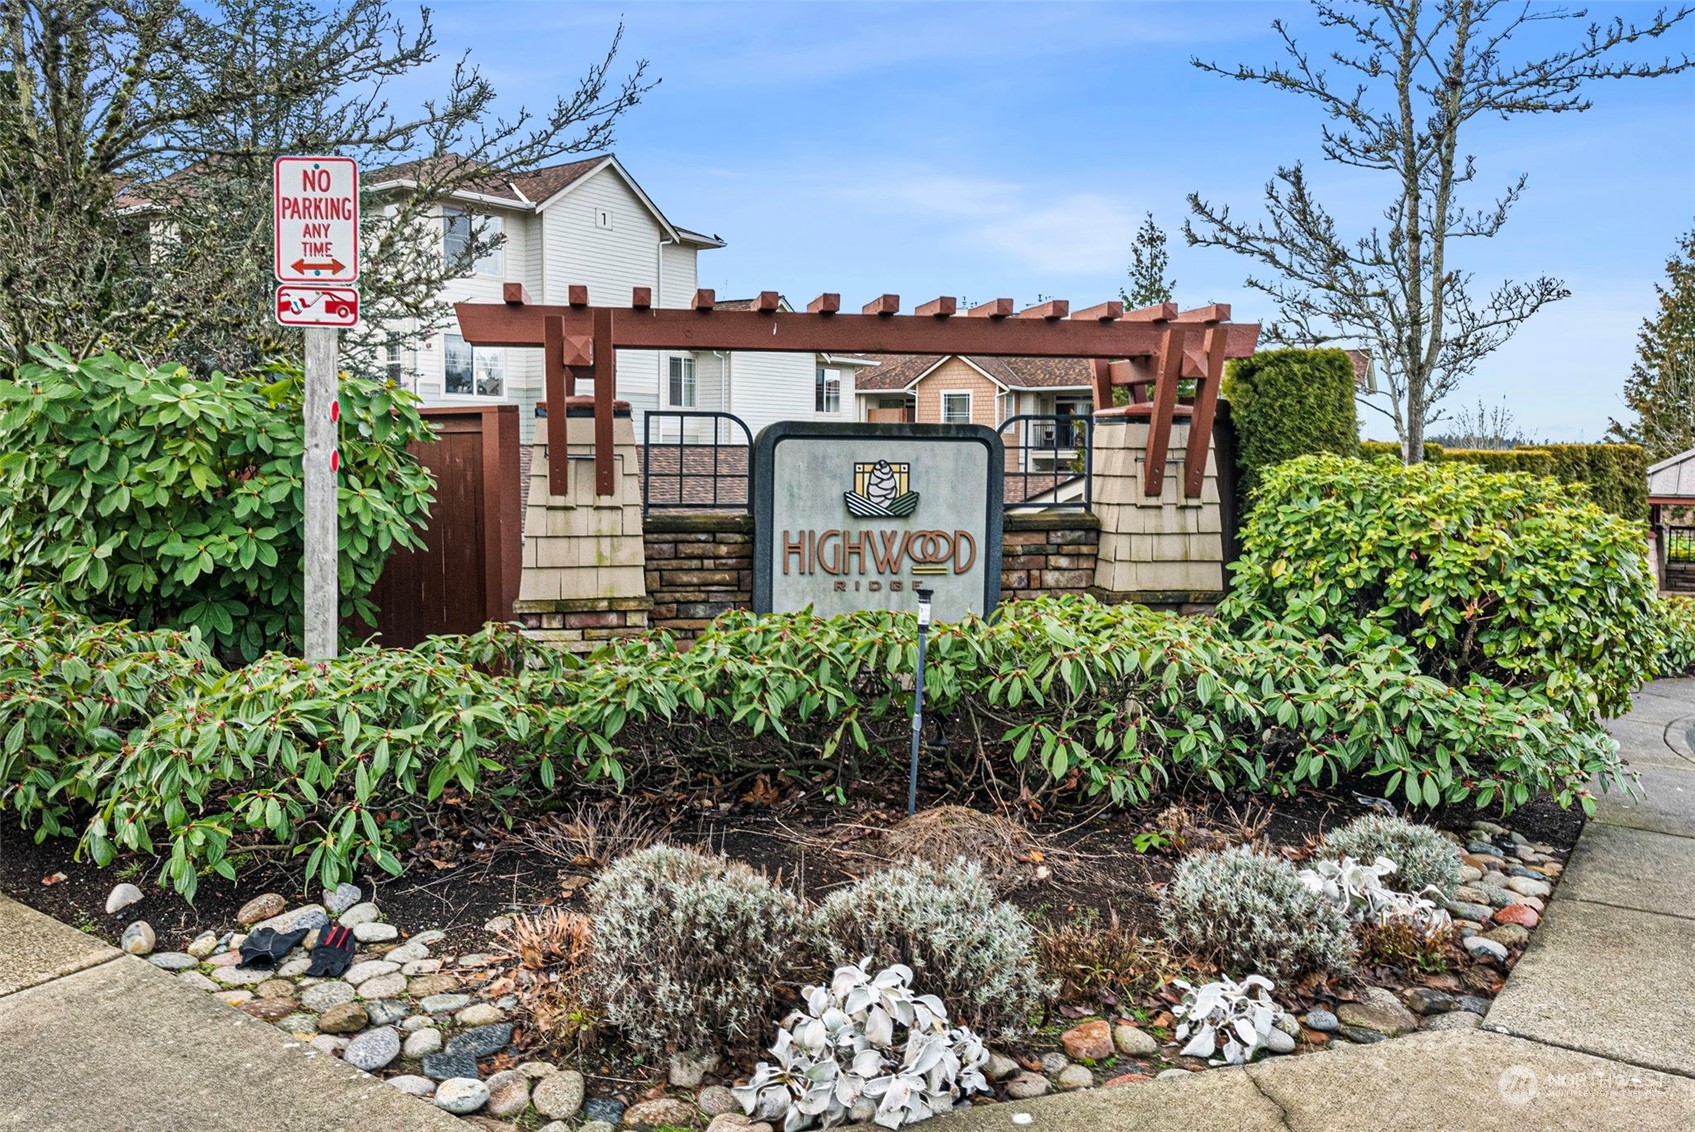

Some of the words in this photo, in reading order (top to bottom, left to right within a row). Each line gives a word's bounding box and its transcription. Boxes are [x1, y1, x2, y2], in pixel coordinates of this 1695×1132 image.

[302, 169, 331, 192] NO
[282, 197, 351, 220] PARKING
[601, 213, 606, 225] 1
[302, 223, 331, 238] ANY
[302, 242, 333, 257] TIME
[783, 529, 977, 575] HIGHWOOD
[834, 580, 923, 592] RIDGE
